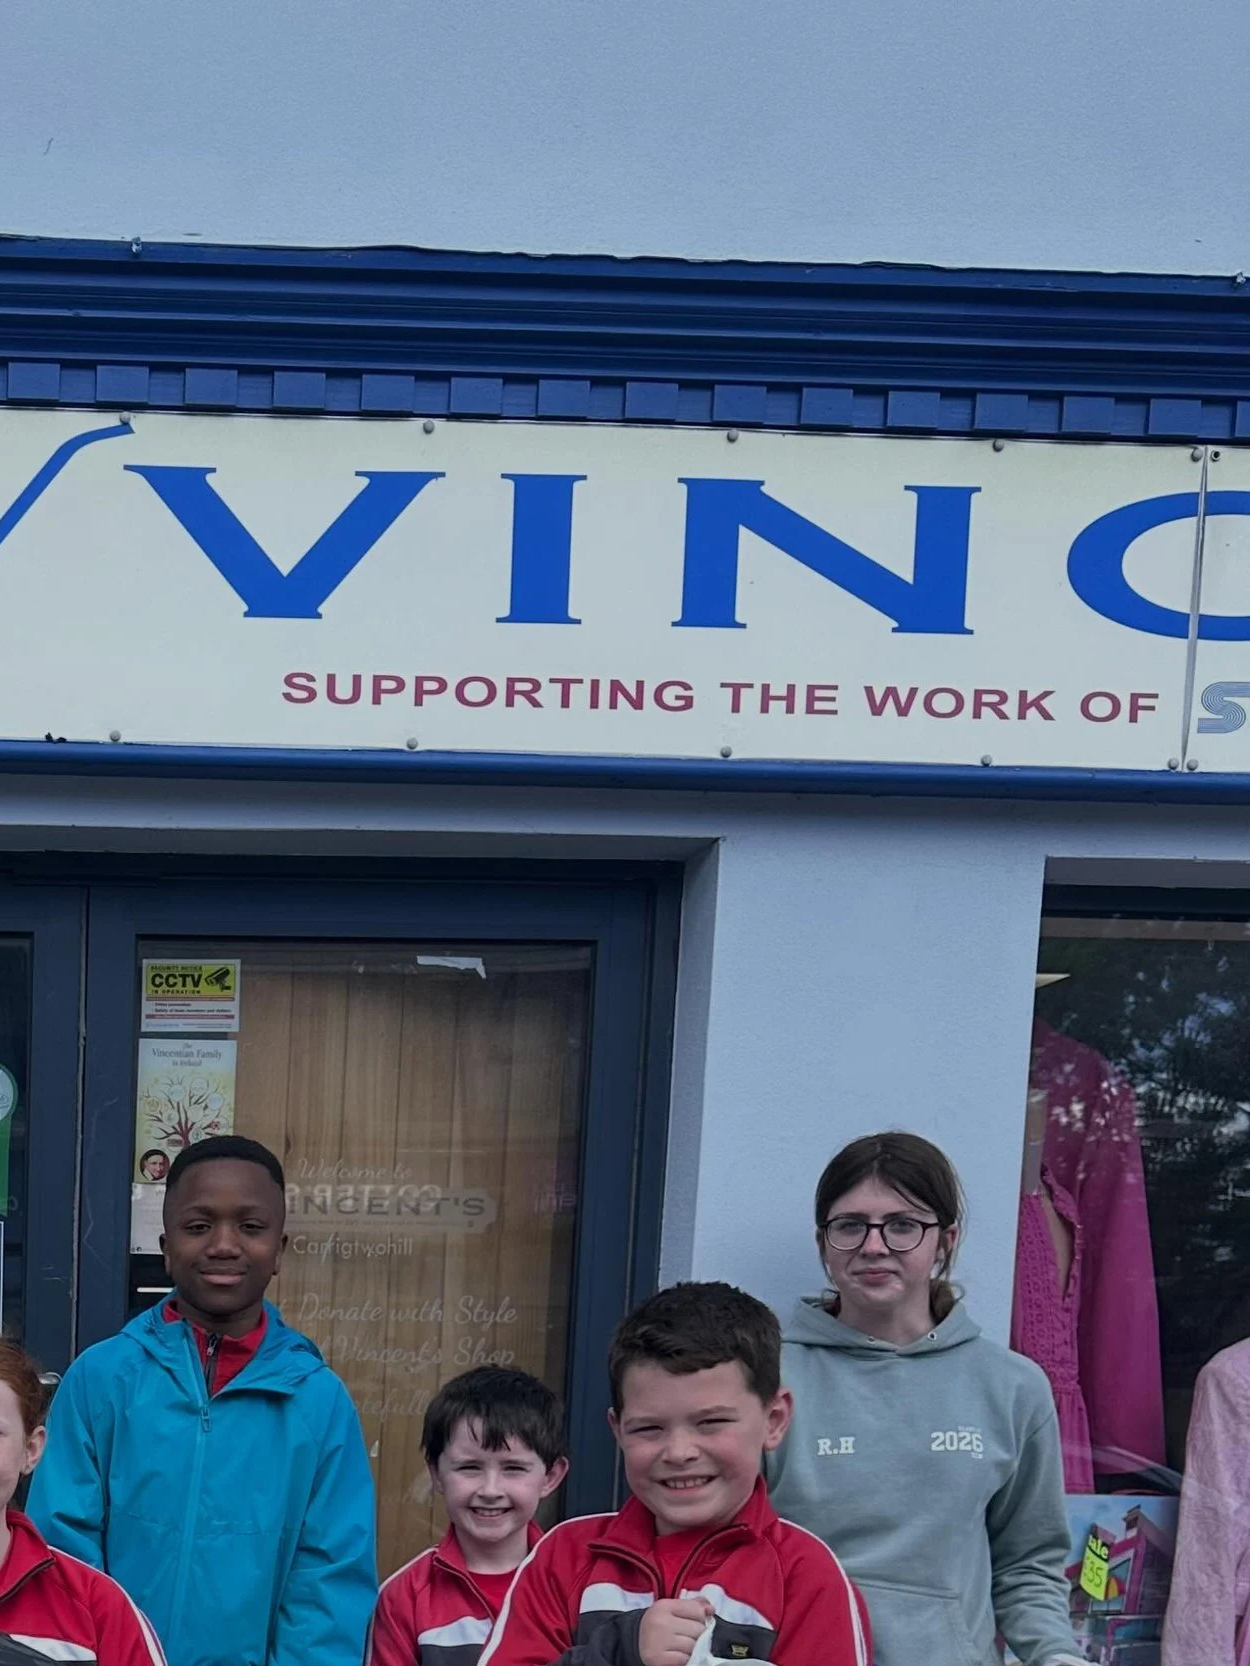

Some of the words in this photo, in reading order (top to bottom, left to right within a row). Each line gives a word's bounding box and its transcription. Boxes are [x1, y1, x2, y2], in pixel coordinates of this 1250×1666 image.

[282, 671, 695, 713] SUPPORTING
[720, 682, 840, 716] THE
[863, 685, 1058, 722] WORK
[1079, 691, 1159, 724] OF
[151, 973, 203, 988] CCTV
[152, 1048, 194, 1058] Vincentian
[197, 1049, 222, 1060] Family
[297, 1158, 387, 1180] Welcome
[394, 1160, 413, 1180] to
[298, 1292, 383, 1323] Donate
[390, 1298, 443, 1323] with
[454, 1295, 518, 1329] Style
[453, 1336, 515, 1367] Shop
[931, 1431, 983, 1452] 2026
